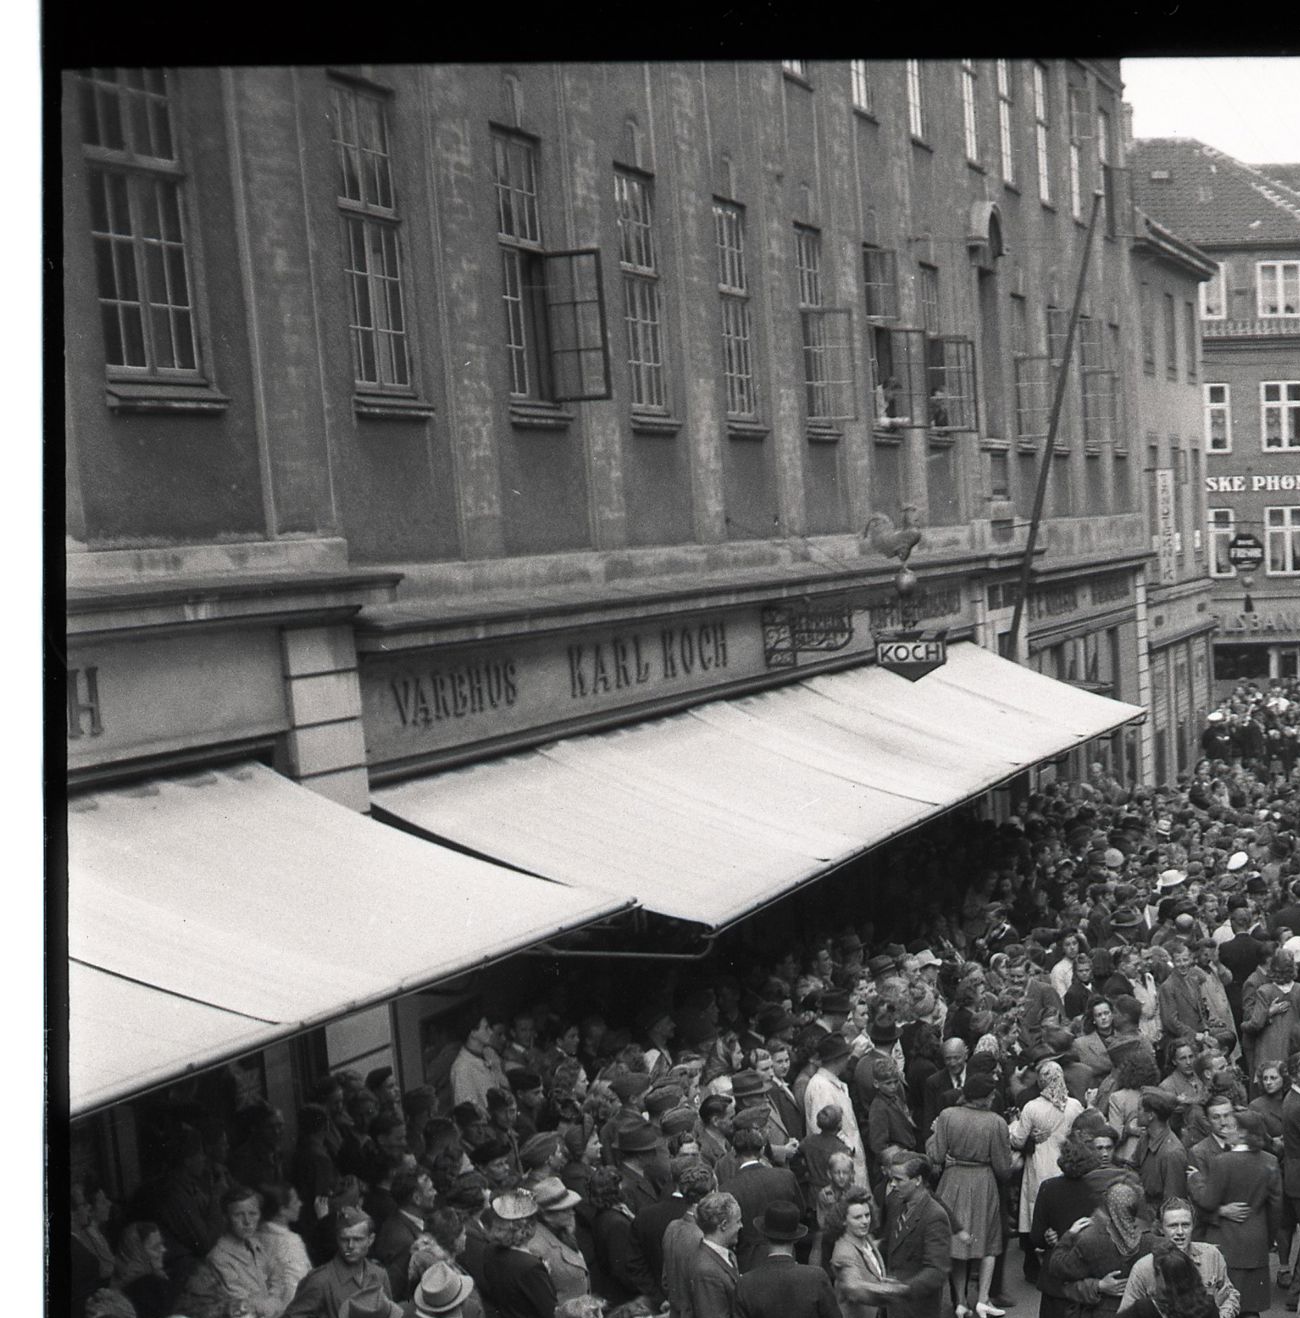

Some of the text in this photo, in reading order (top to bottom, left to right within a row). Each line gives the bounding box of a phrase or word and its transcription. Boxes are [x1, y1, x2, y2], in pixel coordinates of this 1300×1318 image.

[1205, 475, 1246, 492] SKE
[879, 640, 942, 664] KOCH
[391, 660, 519, 729] VAREHUS
[566, 634, 652, 699] KARL
[660, 621, 728, 679] KOCH
